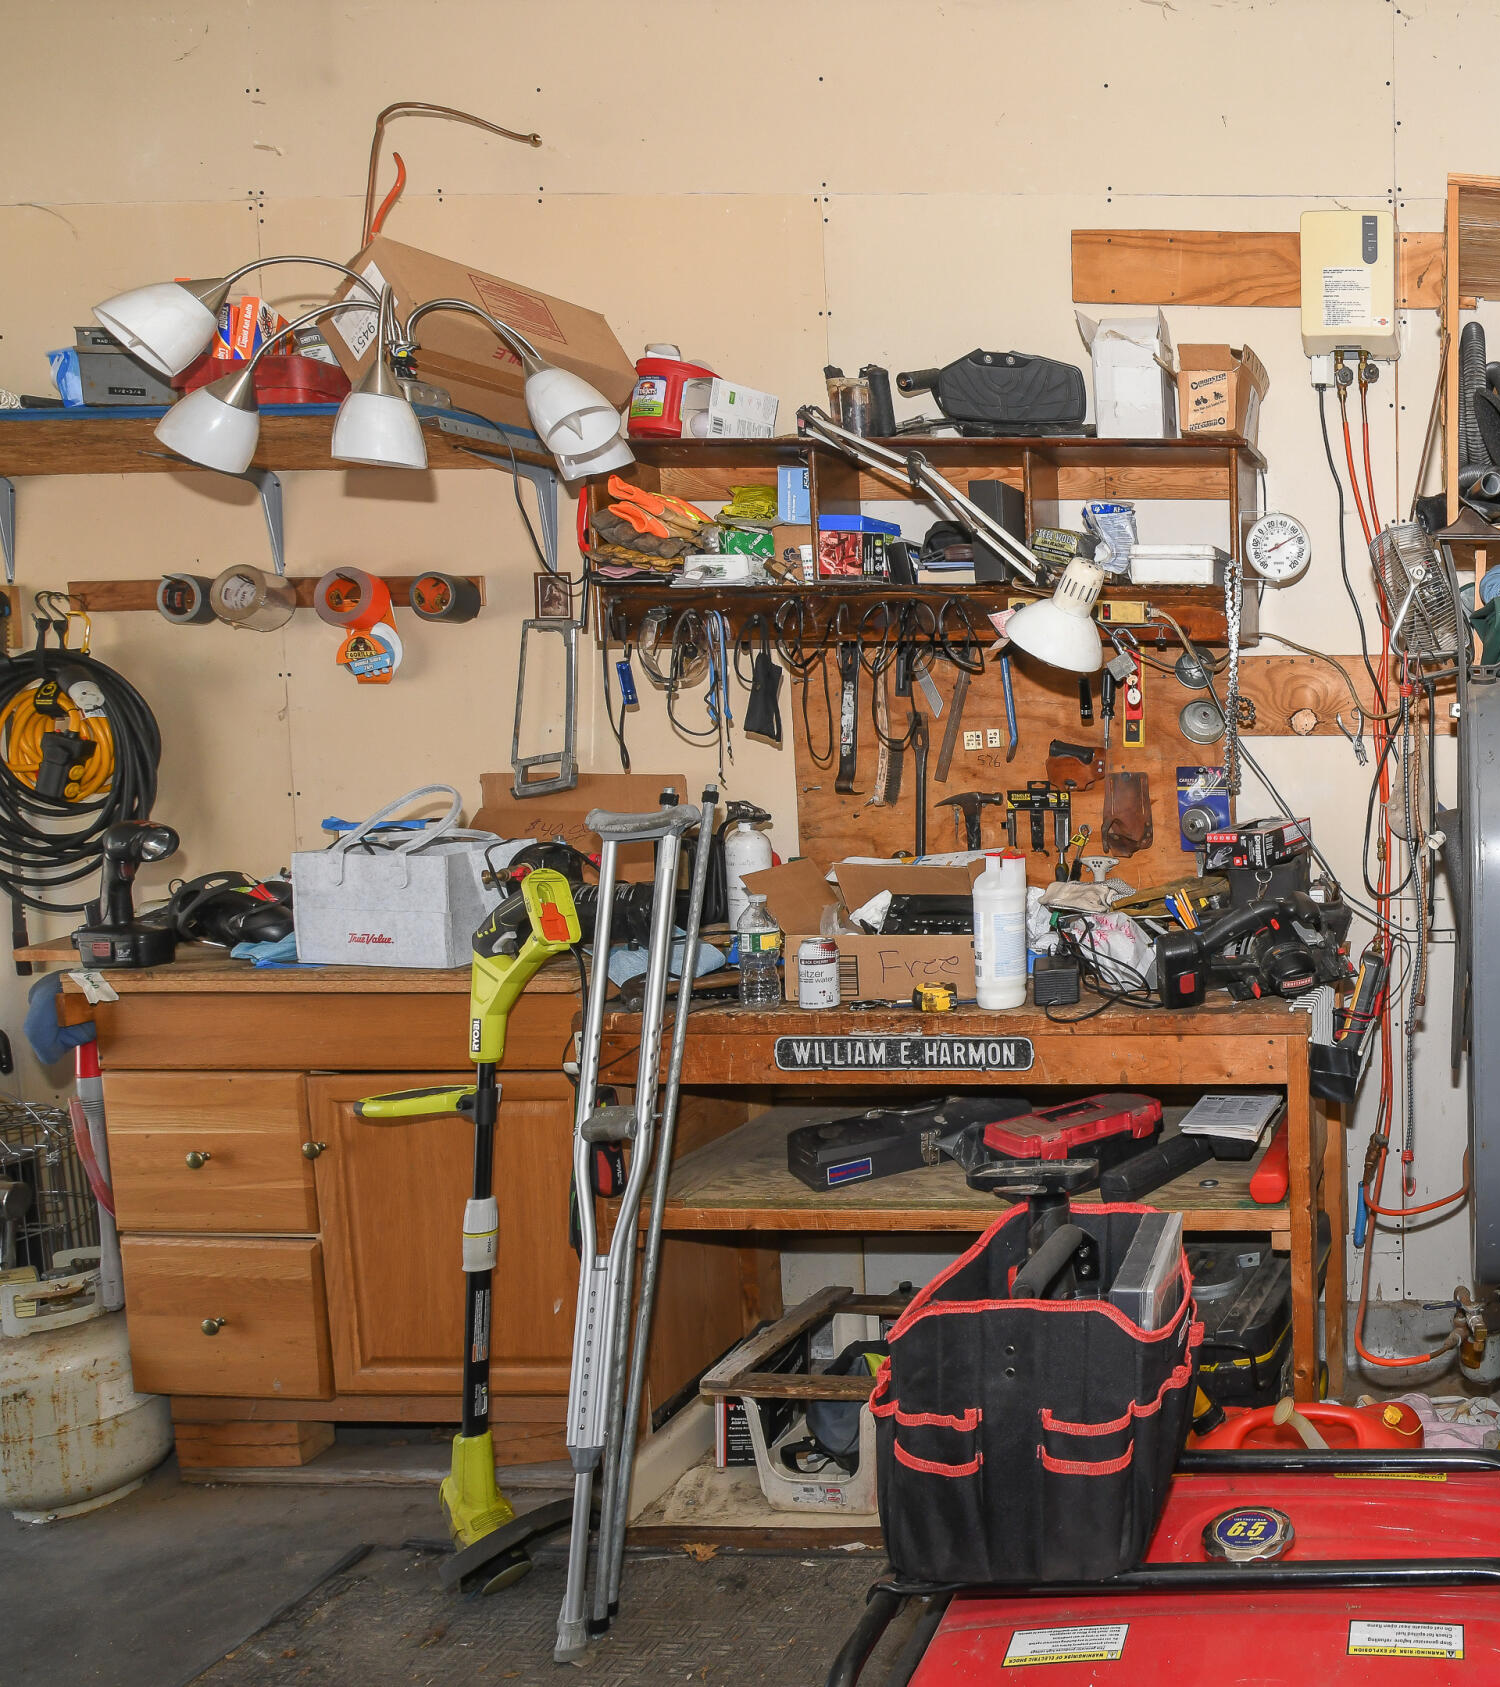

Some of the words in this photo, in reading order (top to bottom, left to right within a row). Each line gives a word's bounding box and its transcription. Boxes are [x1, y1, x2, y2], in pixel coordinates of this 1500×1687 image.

[239, 326, 249, 349] Liquid
[352, 320, 377, 355] 9451
[799, 970, 825, 979] eltzer
[877, 950, 961, 984] Free
[472, 1019, 482, 1052] RYOBI
[792, 1042, 886, 1066] WILLIAM
[900, 1042, 918, 1066] E.
[924, 1042, 1016, 1066] HARMON
[1226, 1521, 1268, 1537] 6.5
